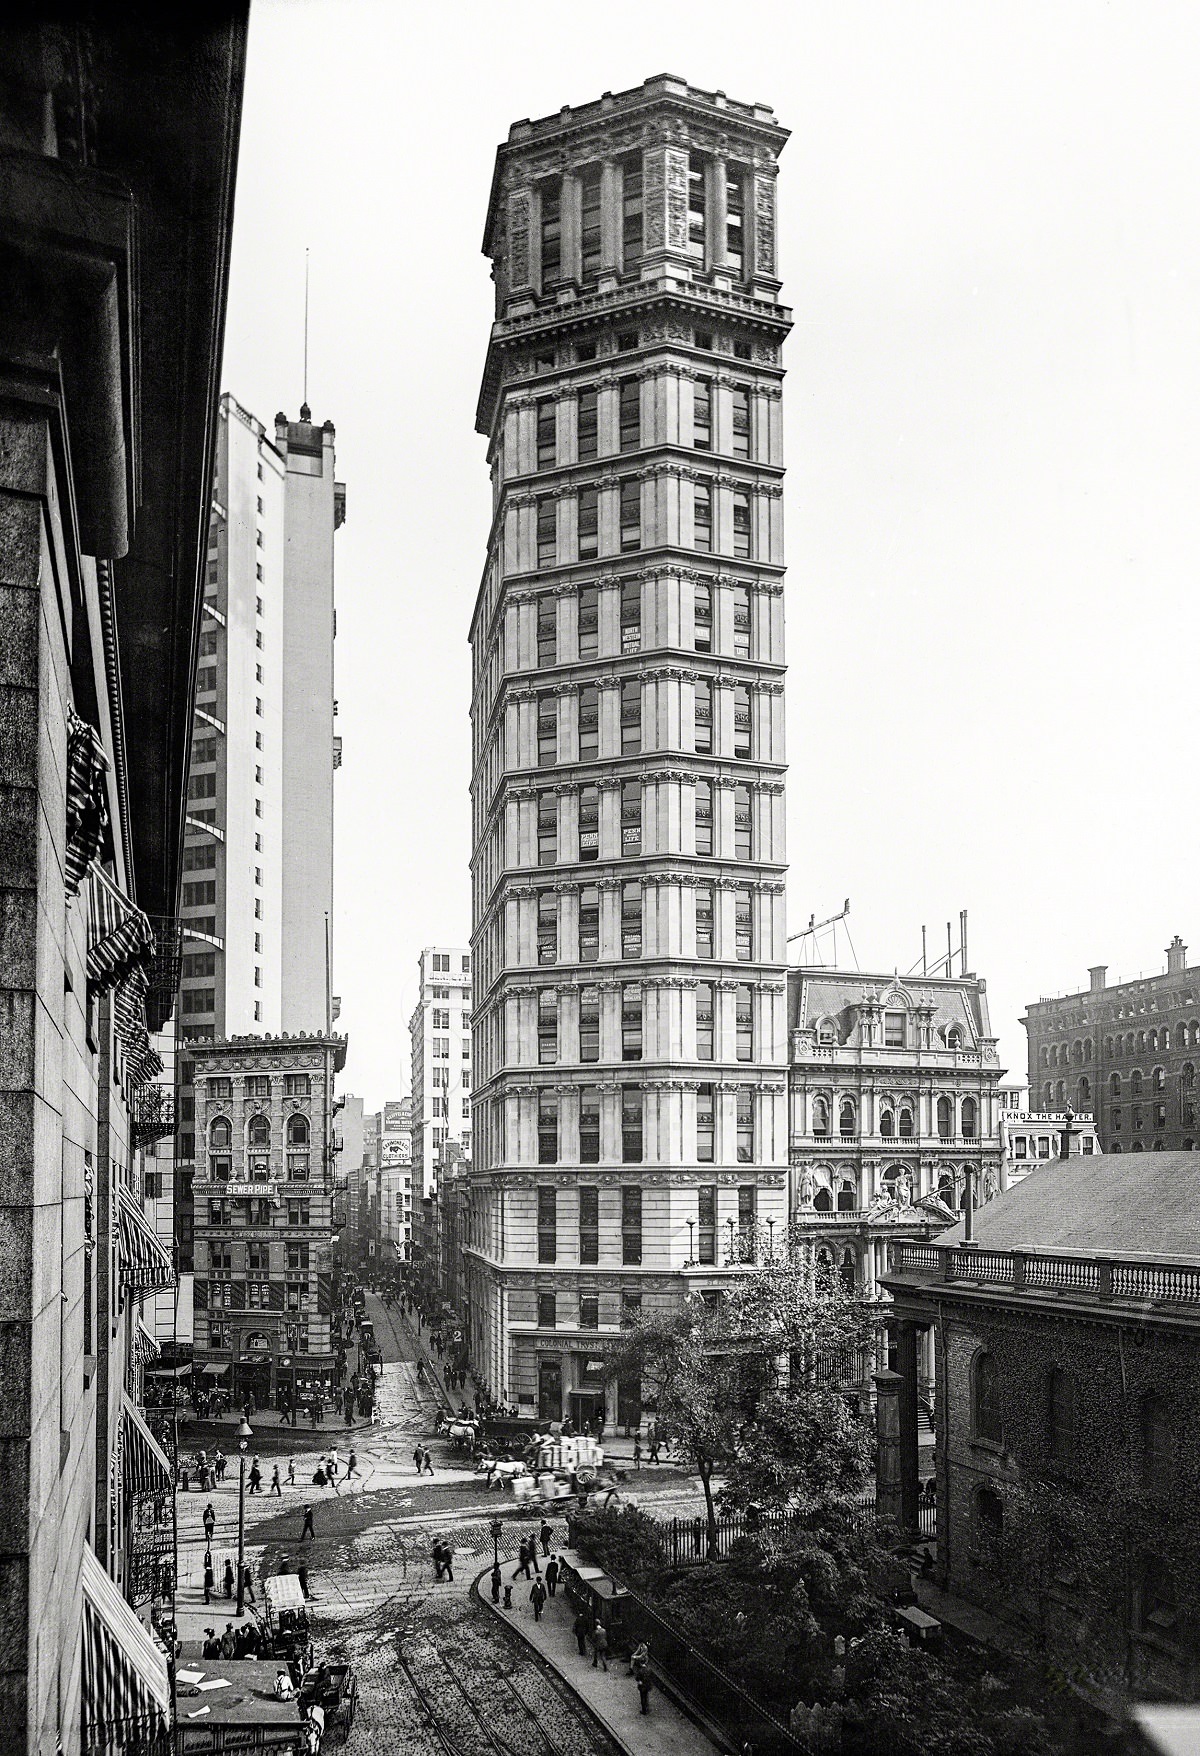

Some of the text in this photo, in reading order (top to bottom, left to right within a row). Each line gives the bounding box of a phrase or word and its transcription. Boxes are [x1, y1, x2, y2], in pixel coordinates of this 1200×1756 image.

[1055, 1112, 1092, 1120] HATER.
[226, 1184, 274, 1194] SEWER PIPE
[453, 1330, 462, 1342] 2
[540, 1338, 573, 1348] COLONIAL
